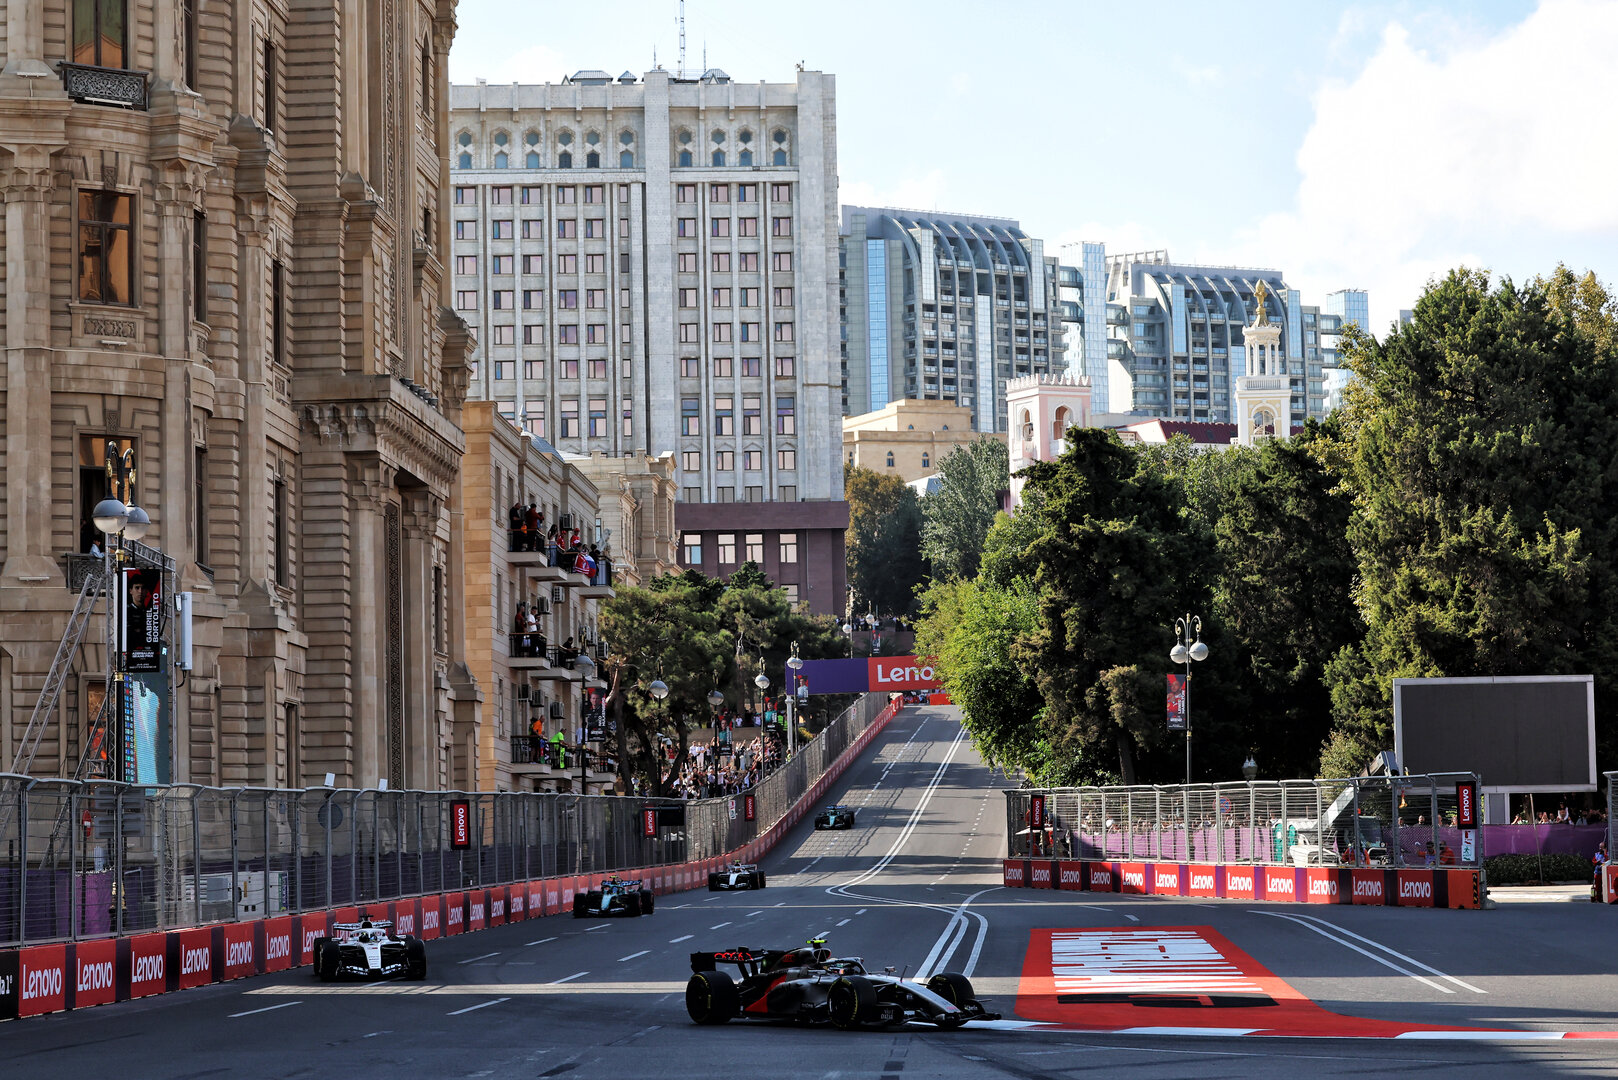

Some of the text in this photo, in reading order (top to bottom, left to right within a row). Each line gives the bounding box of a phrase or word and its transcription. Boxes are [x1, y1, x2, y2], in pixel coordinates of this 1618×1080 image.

[877, 664, 935, 683] Leno
[1462, 788, 1470, 822] Lenovo
[457, 807, 465, 842] Lenovo
[1005, 865, 1022, 881] Lenovo
[1032, 866, 1050, 882] Lenovo
[1060, 867, 1080, 884] Lenovo
[1090, 868, 1111, 885] Lenovo
[1122, 869, 1143, 886] Lenovo
[1155, 870, 1177, 888] Lenovo
[1190, 872, 1213, 889] Lenovo
[1227, 872, 1252, 891] Lenovo
[1267, 874, 1293, 893] Lenovo
[1309, 874, 1336, 895] Lenovo
[1353, 876, 1381, 896] Lenovo
[1399, 877, 1430, 898] Lenovo
[470, 900, 484, 921] Lenovo
[491, 897, 504, 918] Lenovo
[511, 893, 523, 913] Lenovo
[396, 912, 413, 935] Lenovo
[422, 907, 439, 930] Lenovo
[448, 903, 463, 925] Lenovo
[226, 937, 252, 967] Lenovo
[266, 932, 289, 960] Lenovo
[131, 951, 163, 983] Lenovo
[181, 944, 209, 975] Lenovo
[22, 964, 62, 1000] Lenovo
[77, 958, 112, 992] Lenovo
